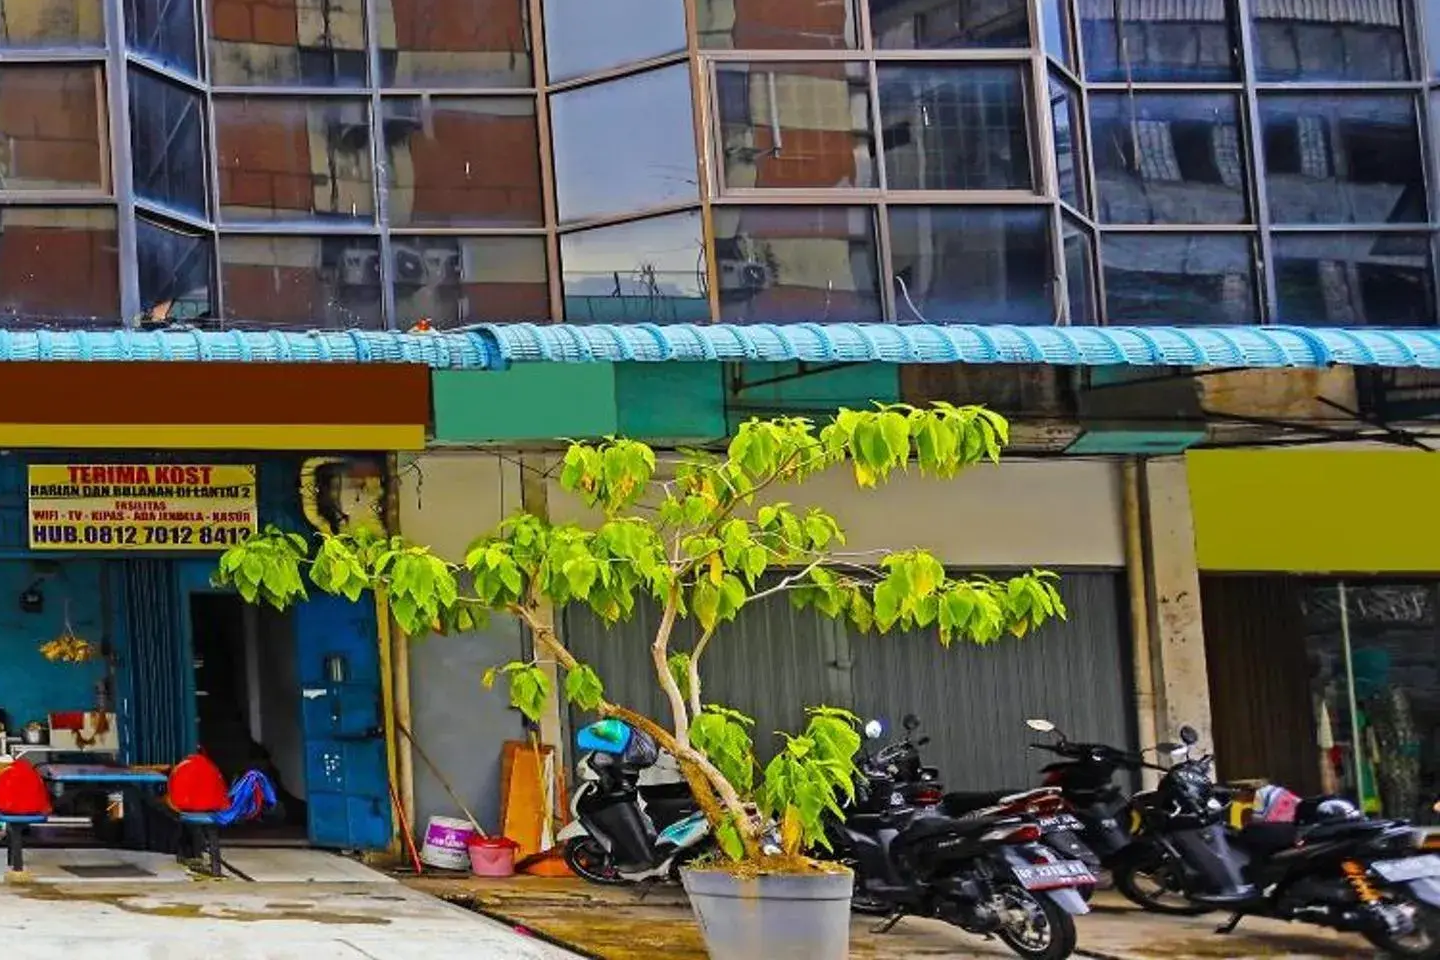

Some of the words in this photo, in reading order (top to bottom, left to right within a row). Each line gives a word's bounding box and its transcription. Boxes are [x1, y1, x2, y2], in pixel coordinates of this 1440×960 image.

[67, 466, 150, 484] TERIMA
[155, 466, 213, 485] KOST
[31, 485, 79, 496] HARIAN
[83, 486, 110, 497] DAN
[113, 486, 174, 497] BULANAN
[241, 487, 251, 498] 2
[115, 500, 167, 511] FASILITAS
[33, 510, 59, 521] WIFI
[68, 510, 83, 521] TV
[91, 511, 125, 521] KIPAS
[133, 511, 158, 521] ADA
[212, 512, 251, 522] KASUR
